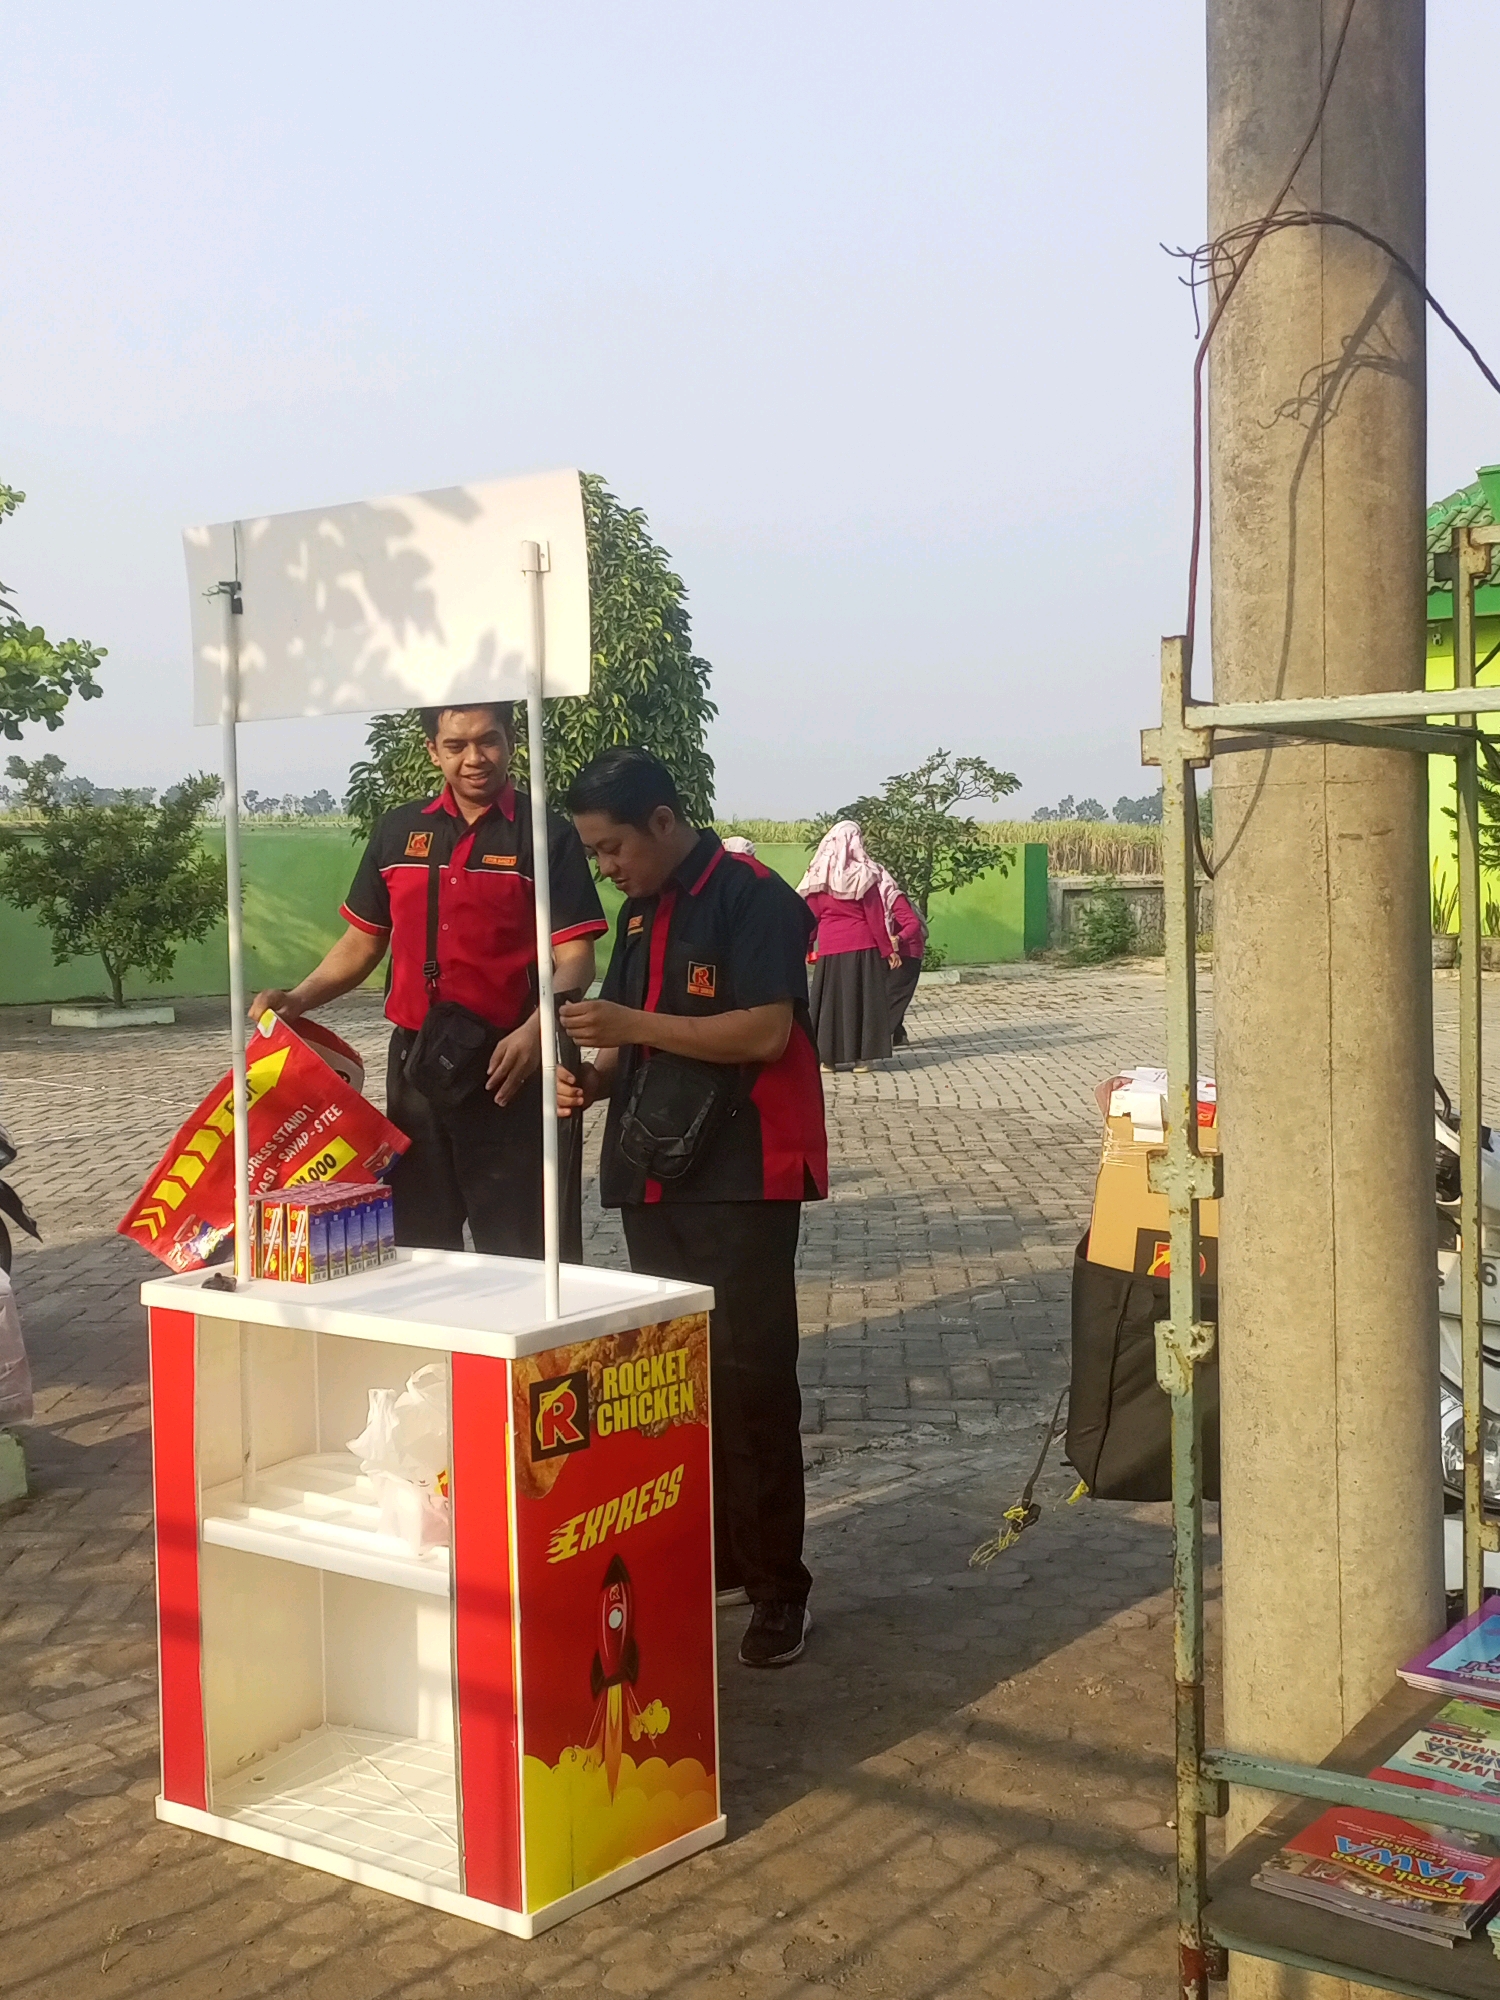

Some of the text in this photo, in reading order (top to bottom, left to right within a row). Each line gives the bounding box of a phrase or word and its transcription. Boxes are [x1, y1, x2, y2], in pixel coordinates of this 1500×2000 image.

[247, 1142, 278, 1181] PRESS
[272, 1110, 307, 1143] STAND
[278, 1131, 309, 1163] SAYAP
[602, 1347, 689, 1400] ROCKET
[597, 1380, 695, 1437] CHICKEN
[545, 1463, 685, 1564] EXPRESS
[1330, 1850, 1386, 1875] Basa
[1334, 1834, 1486, 1885] JAWA
[1370, 1838, 1448, 1866] Lengkap
[1393, 1867, 1467, 1896] Pepak
